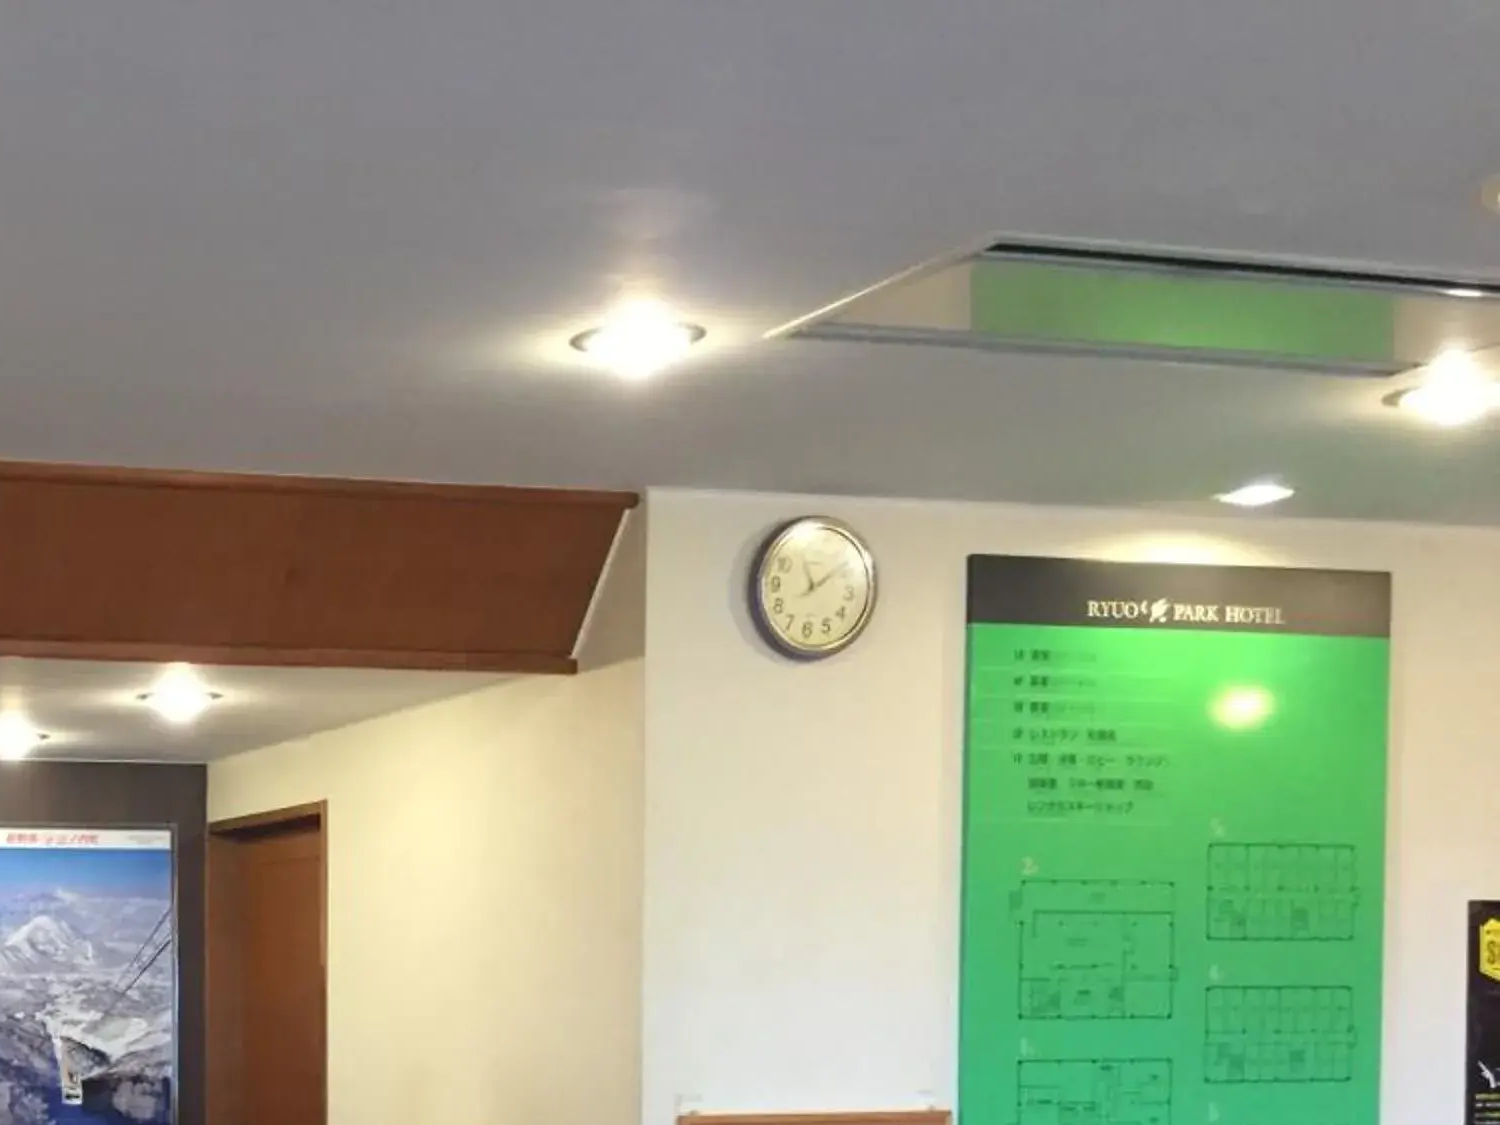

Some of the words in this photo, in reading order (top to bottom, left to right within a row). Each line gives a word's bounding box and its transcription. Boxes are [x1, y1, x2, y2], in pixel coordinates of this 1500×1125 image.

[770, 575, 781, 593] 9
[773, 597, 784, 614] 8
[835, 605, 847, 622] 4
[1087, 599, 1139, 619] RYUO
[1173, 603, 1219, 622] PARK
[1225, 605, 1286, 625] HOTEL
[785, 613, 795, 630] 7
[802, 621, 813, 638] 6
[821, 617, 831, 634] 5
